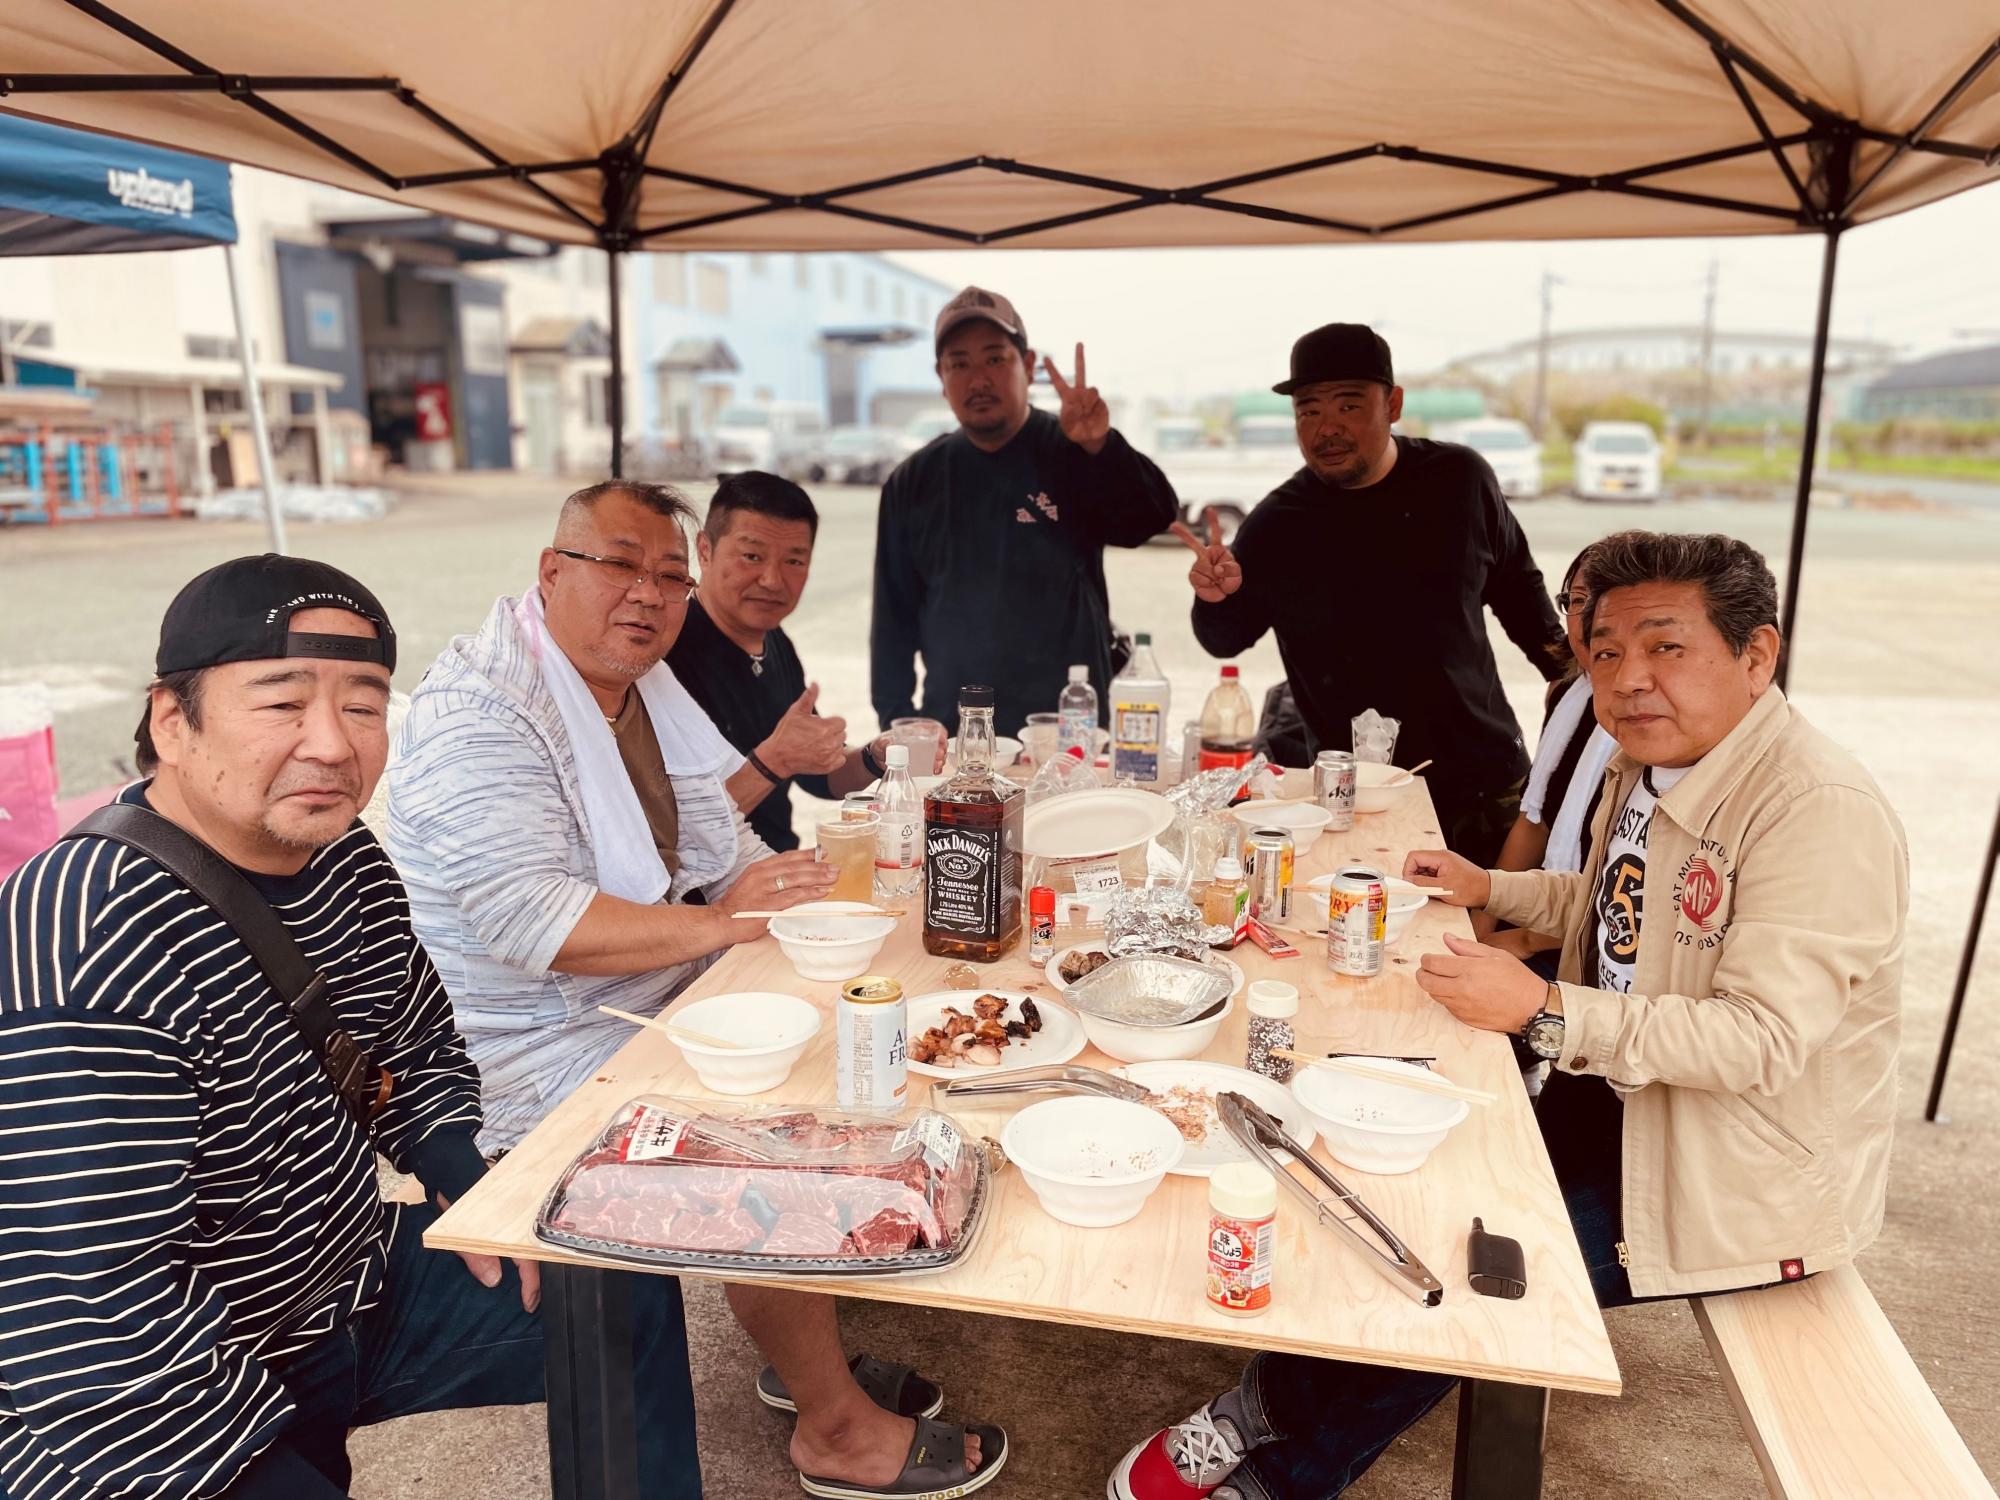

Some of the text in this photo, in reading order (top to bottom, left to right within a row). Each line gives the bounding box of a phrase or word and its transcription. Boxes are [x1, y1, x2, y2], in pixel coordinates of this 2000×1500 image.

[308, 593, 334, 601] WITH
[1614, 806, 1645, 842] AST
[927, 834, 992, 863] JACK DANIEL'S
[948, 862, 968, 871] No.7
[936, 876, 979, 891] Tennessee
[1098, 876, 1119, 888] 1723
[937, 891, 978, 903] WHISKEY
[918, 1486, 964, 1500] crocs
